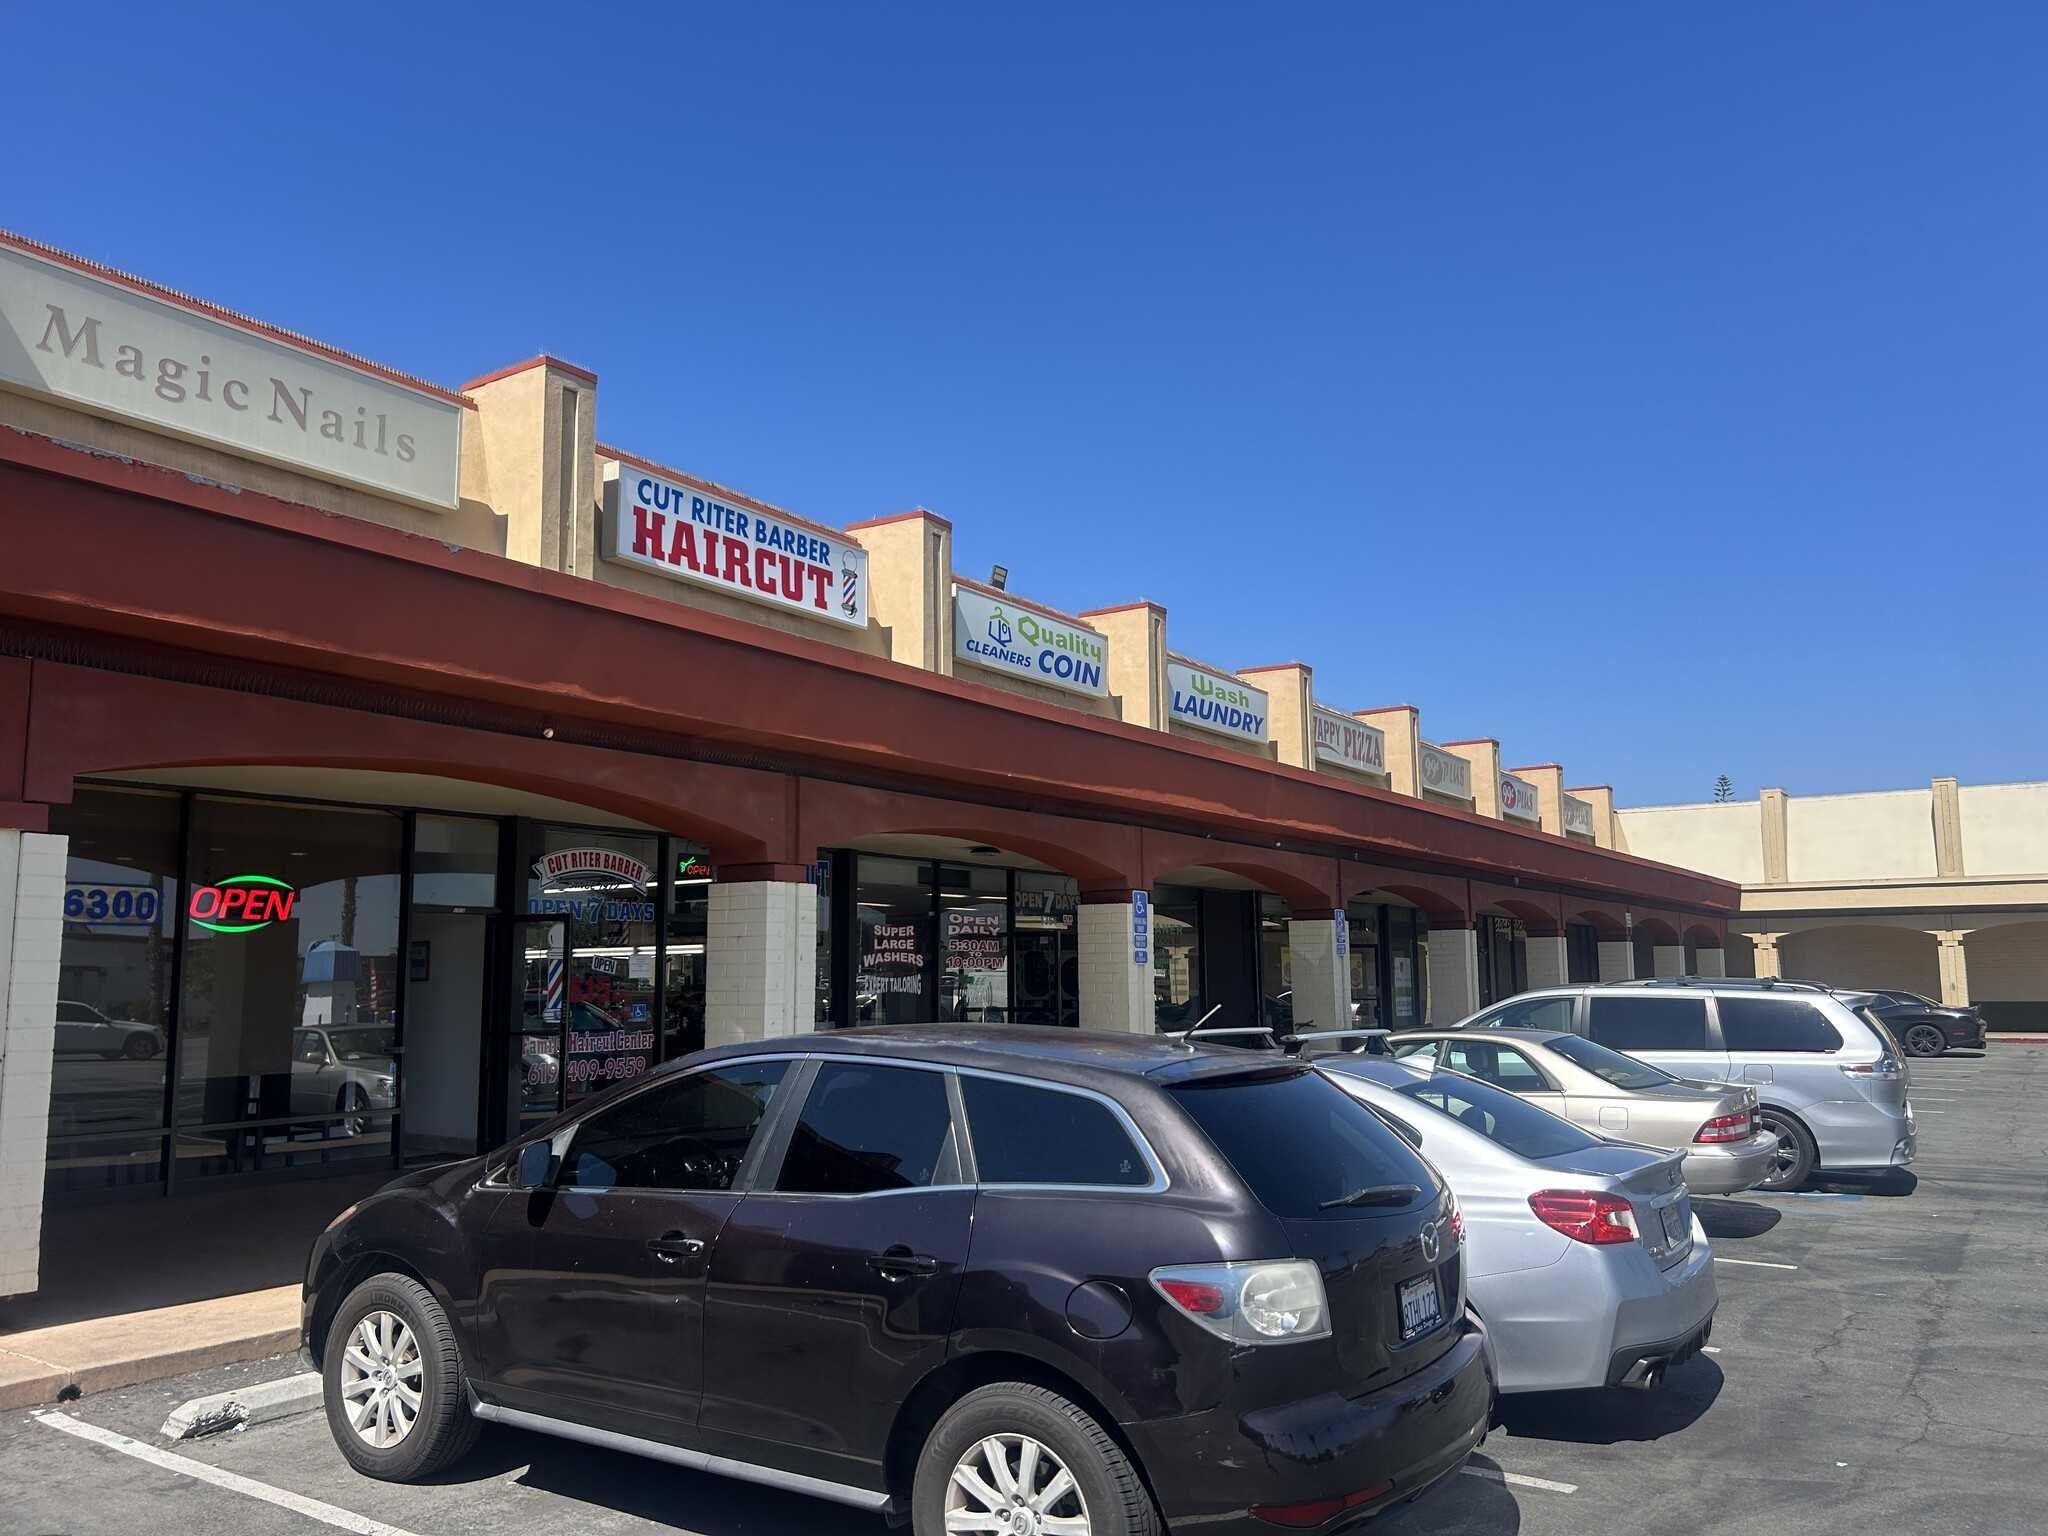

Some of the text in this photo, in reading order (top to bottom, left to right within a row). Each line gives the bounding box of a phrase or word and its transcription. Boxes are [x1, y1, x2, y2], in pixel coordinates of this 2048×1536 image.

[36, 303, 416, 463] Magic Nails
[637, 479, 830, 566] CUT RITER BARBER
[632, 505, 833, 610] HAIRCUT
[1018, 616, 1101, 663] Quality
[966, 639, 1100, 688] CLEANERS COIN
[1191, 674, 1249, 708] Wash
[1173, 691, 1264, 735] LAUNDRY
[1343, 726, 1382, 768] PIZZA
[1443, 760, 1465, 786] PLUS
[1517, 789, 1533, 812] PLUS
[548, 852, 643, 881] CUT RITER BARBER
[687, 865, 710, 876] OPEN
[64, 889, 155, 920] 6300
[189, 887, 295, 921] OPEN
[528, 896, 655, 924] OPEN 7 DAYS
[1015, 891, 1043, 908] OPEN
[1043, 890, 1055, 914] 7
[874, 924, 914, 937] SUPER
[948, 913, 998, 926] OPEN
[948, 924, 1001, 936] DAILY
[874, 938, 914, 950] LARGE
[948, 940, 999, 952] 5:30AM
[594, 956, 616, 973] OPEN
[863, 952, 924, 967] WASHERS
[946, 956, 1004, 969] 10:00PM
[864, 973, 921, 995] EXPERT TAILORING
[568, 1031, 616, 1053] Haircut
[617, 1030, 654, 1050] Center
[528, 1056, 646, 1085] 619 409-9559
